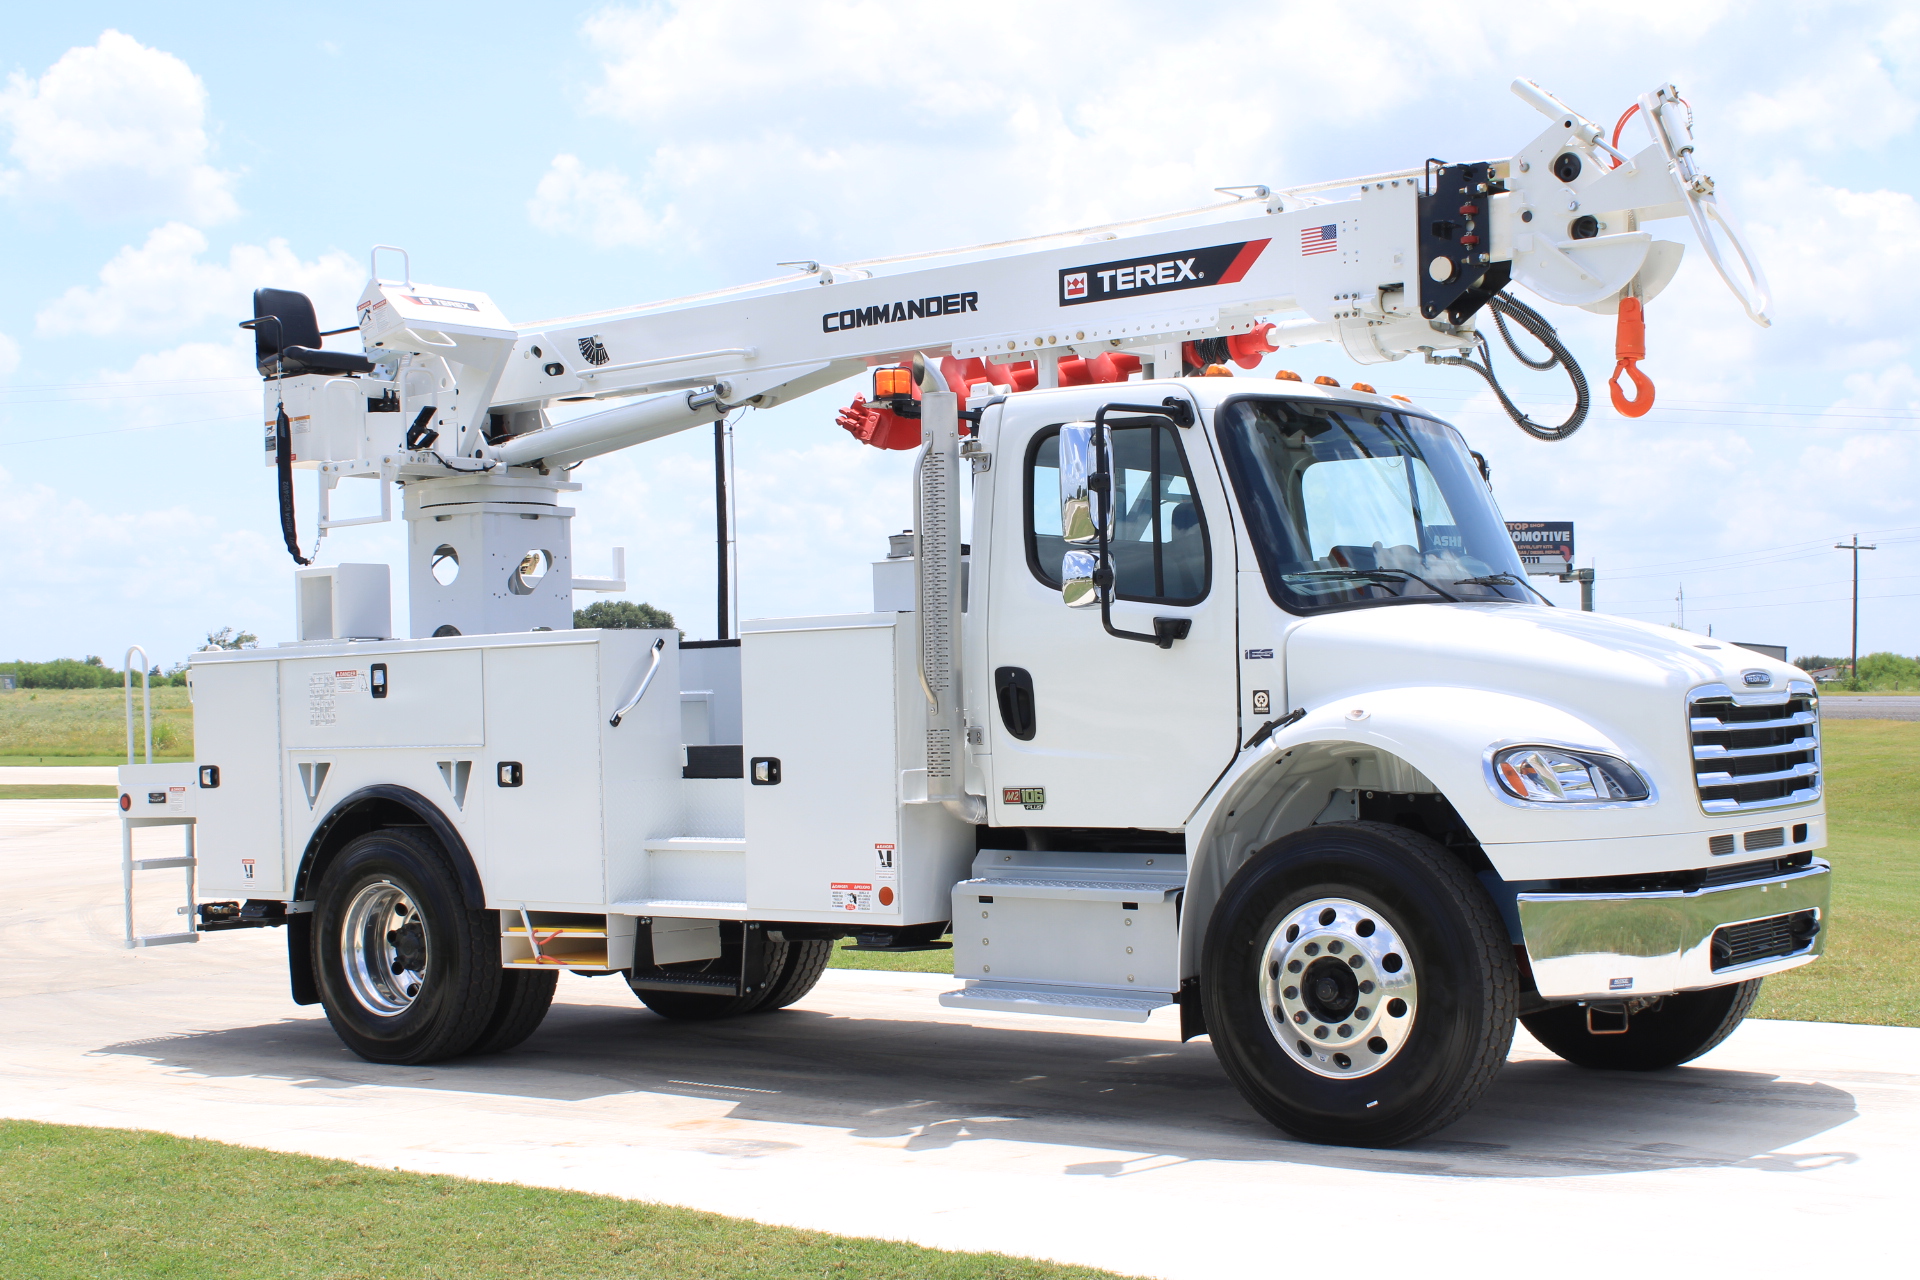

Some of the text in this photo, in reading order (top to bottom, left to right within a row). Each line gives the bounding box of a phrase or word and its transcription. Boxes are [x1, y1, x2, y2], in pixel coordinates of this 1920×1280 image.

[1097, 257, 1196, 293] TEREX
[432, 299, 472, 310] TEREX
[822, 291, 978, 333] COMMANDER
[1510, 531, 1570, 541] OMOTIVE
[1005, 789, 1044, 803] M2 106
